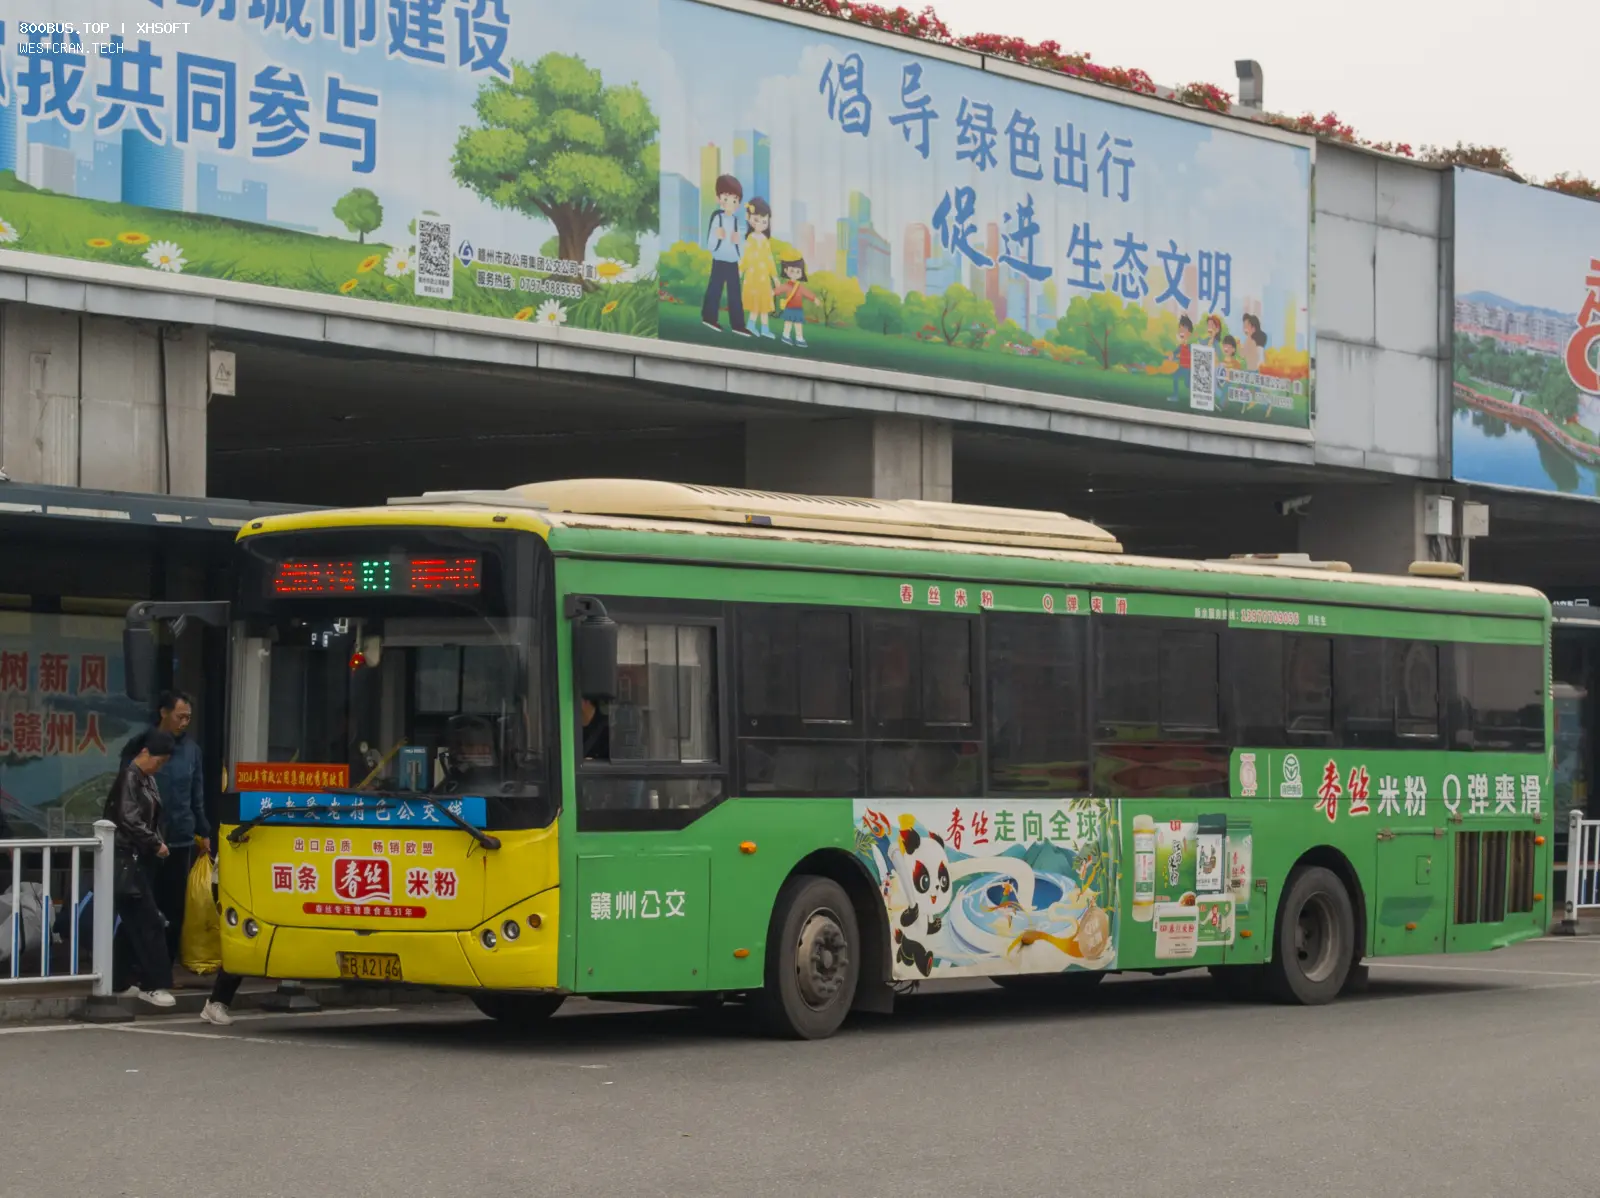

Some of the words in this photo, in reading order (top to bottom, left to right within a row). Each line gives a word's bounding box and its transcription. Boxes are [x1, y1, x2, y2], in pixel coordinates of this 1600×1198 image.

[0, 20, 378, 174] 我共同参与
[0, 712, 107, 754] 赣州人
[294, 838, 351, 853] 出口品质
[373, 841, 433, 855] 畅销欧盟
[273, 865, 317, 891] 面条
[407, 871, 456, 897] 米粉
[590, 890, 685, 920] 赣州公交
